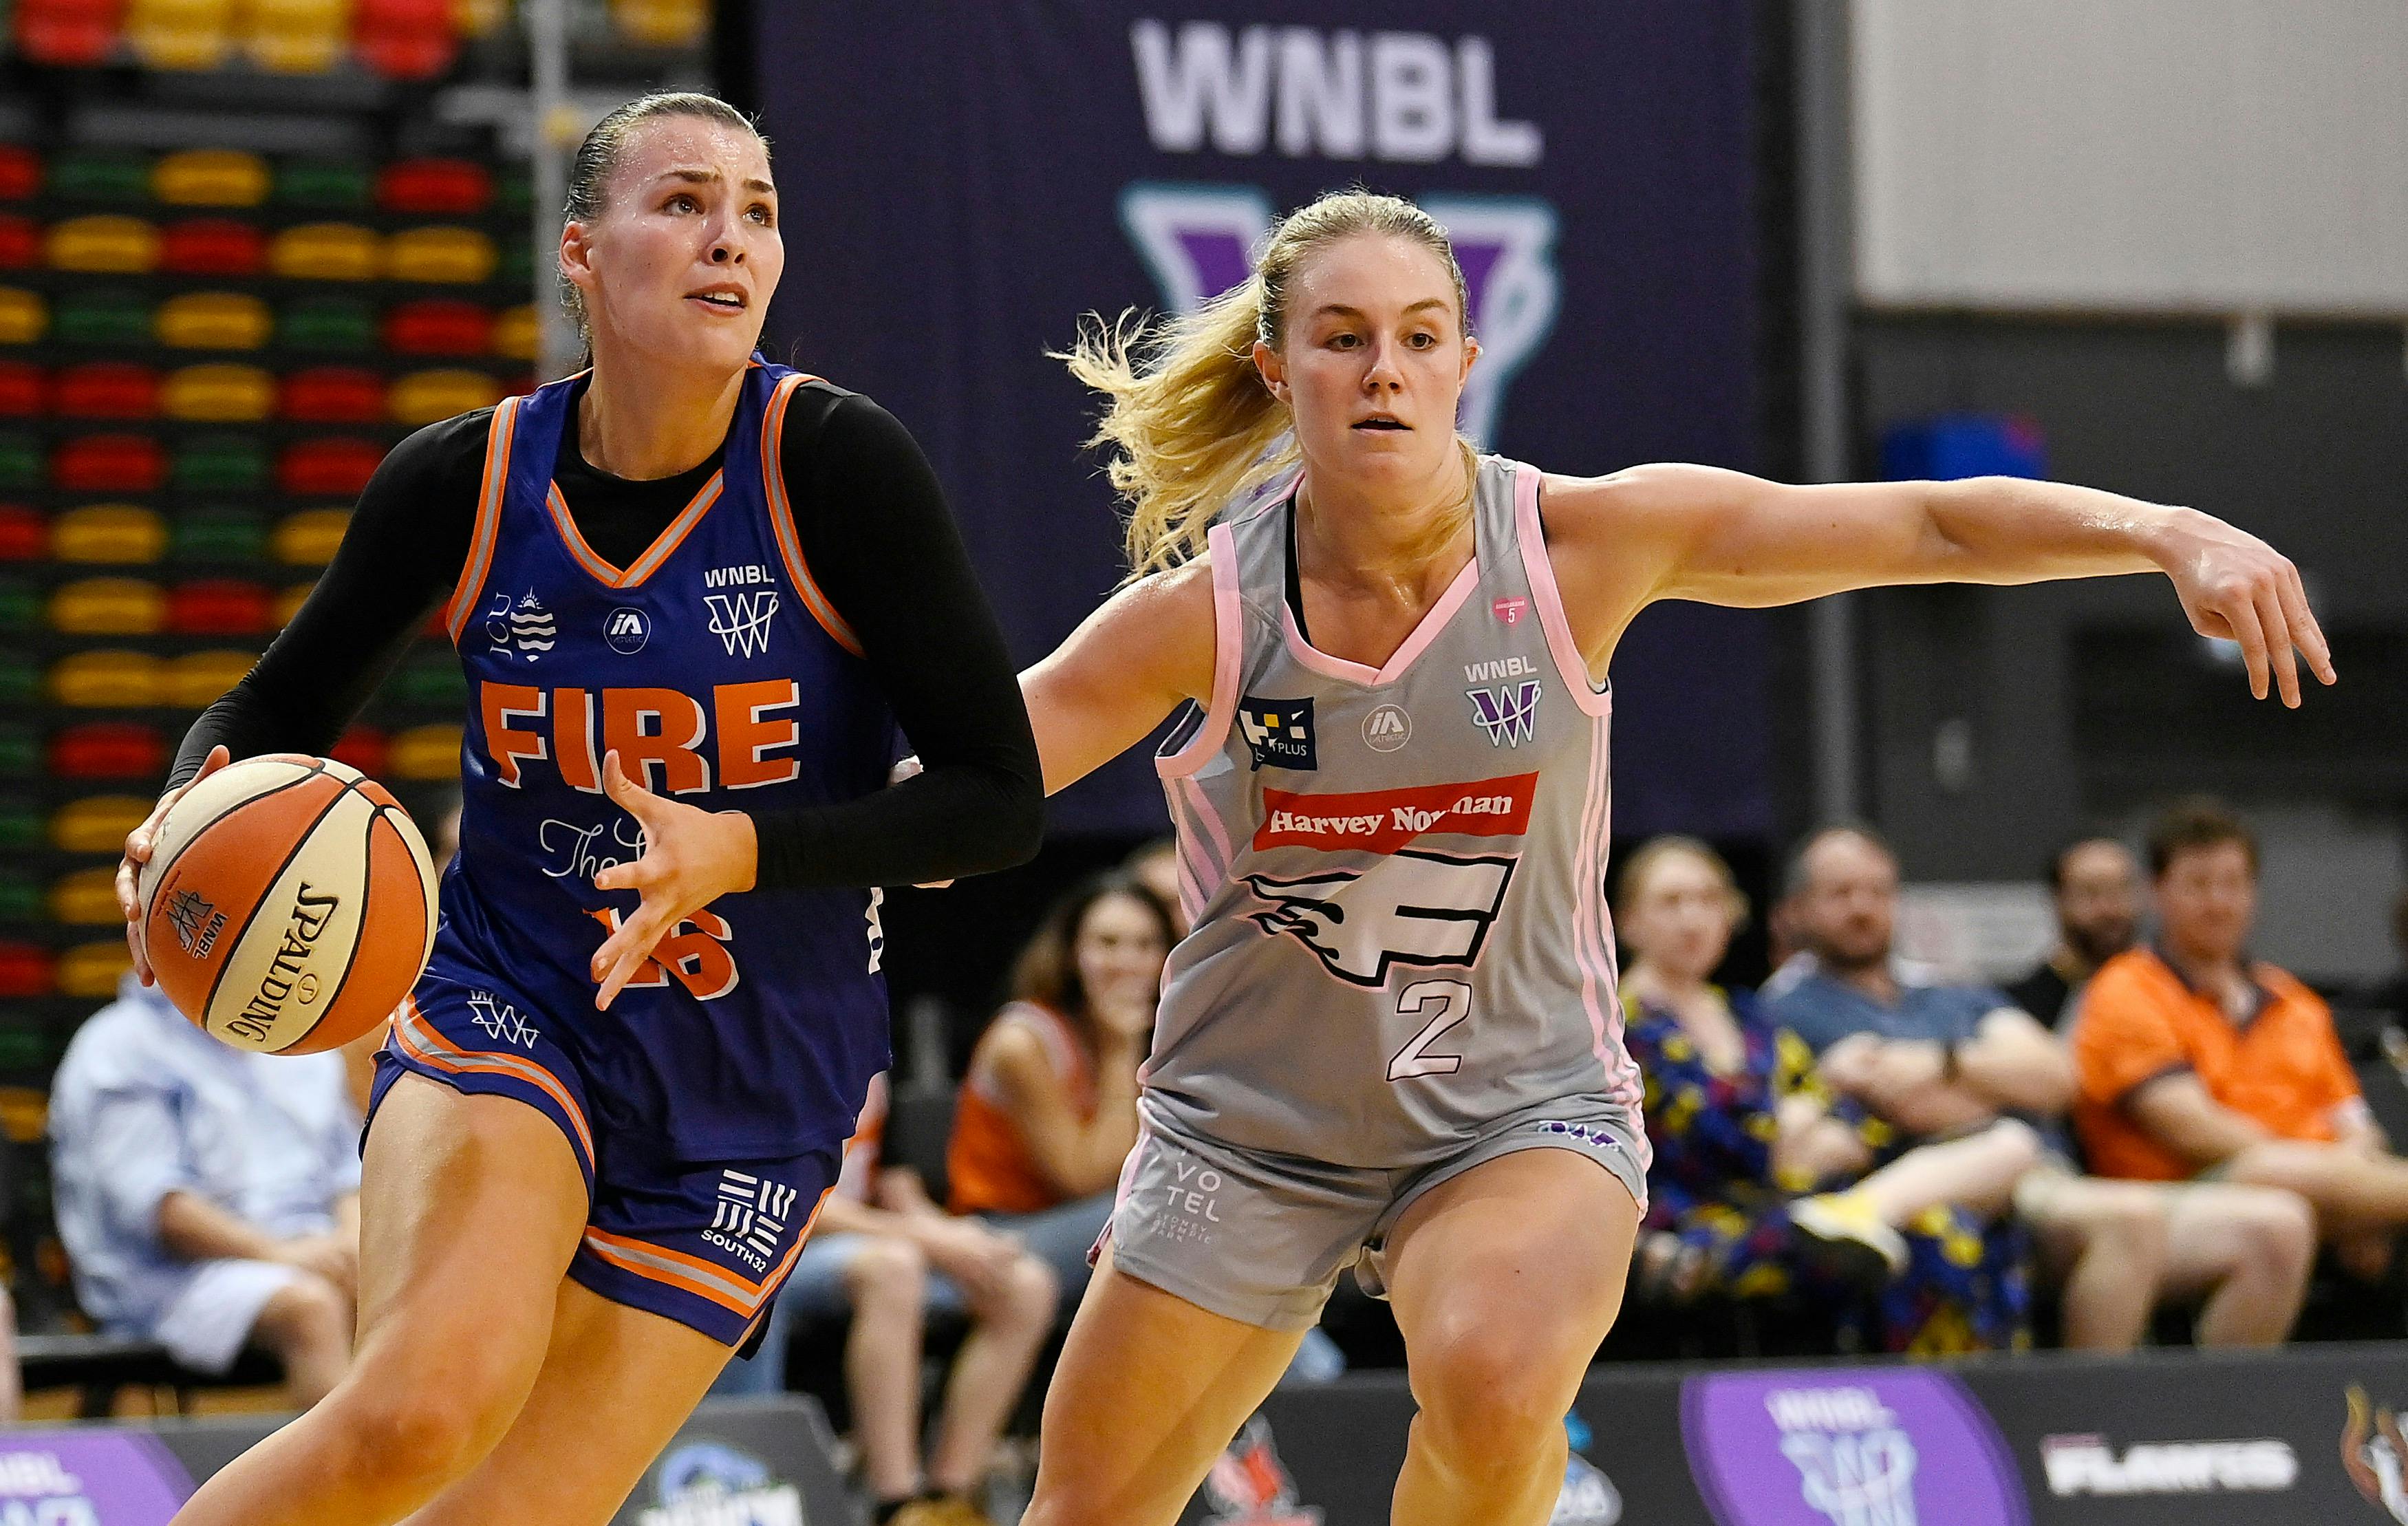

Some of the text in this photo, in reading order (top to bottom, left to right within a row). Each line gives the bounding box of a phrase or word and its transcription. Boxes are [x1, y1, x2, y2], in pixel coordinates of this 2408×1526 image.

[1130, 19, 1546, 167] WNBL
[705, 564, 775, 588] WNBL
[1507, 608, 1516, 623] 5
[1464, 656, 1538, 683] WNBL
[481, 678, 800, 795] FIRE
[1269, 809, 1385, 836] Harvey
[193, 911, 228, 959] WNBL
[226, 881, 338, 1043] SPALDING
[1386, 978, 1473, 1082] 2
[1176, 1161, 1222, 1192] VO
[1167, 1185, 1220, 1223] TEL
[700, 1229, 767, 1273] SOUTH32
